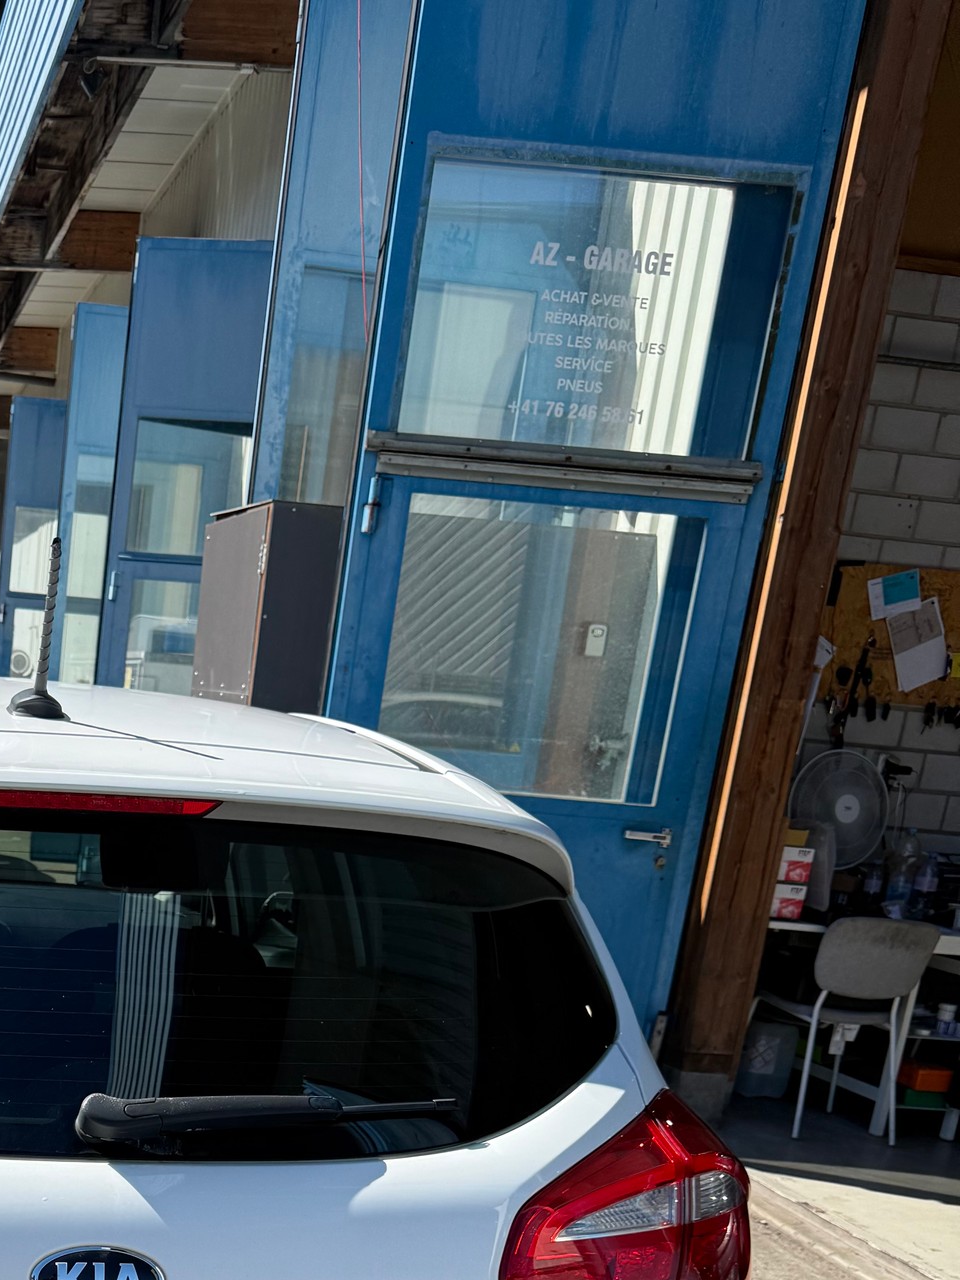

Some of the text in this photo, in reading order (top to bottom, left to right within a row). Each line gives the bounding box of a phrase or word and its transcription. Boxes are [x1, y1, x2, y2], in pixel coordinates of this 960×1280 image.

[529, 241, 561, 267] AZ
[583, 245, 675, 277] GARAGE
[541, 289, 588, 304] ACHAT
[526, 331, 666, 356] UTES LES MARQUES
[556, 378, 604, 395] PNEUS
[546, 401, 565, 418] 76
[567, 402, 599, 421] 246
